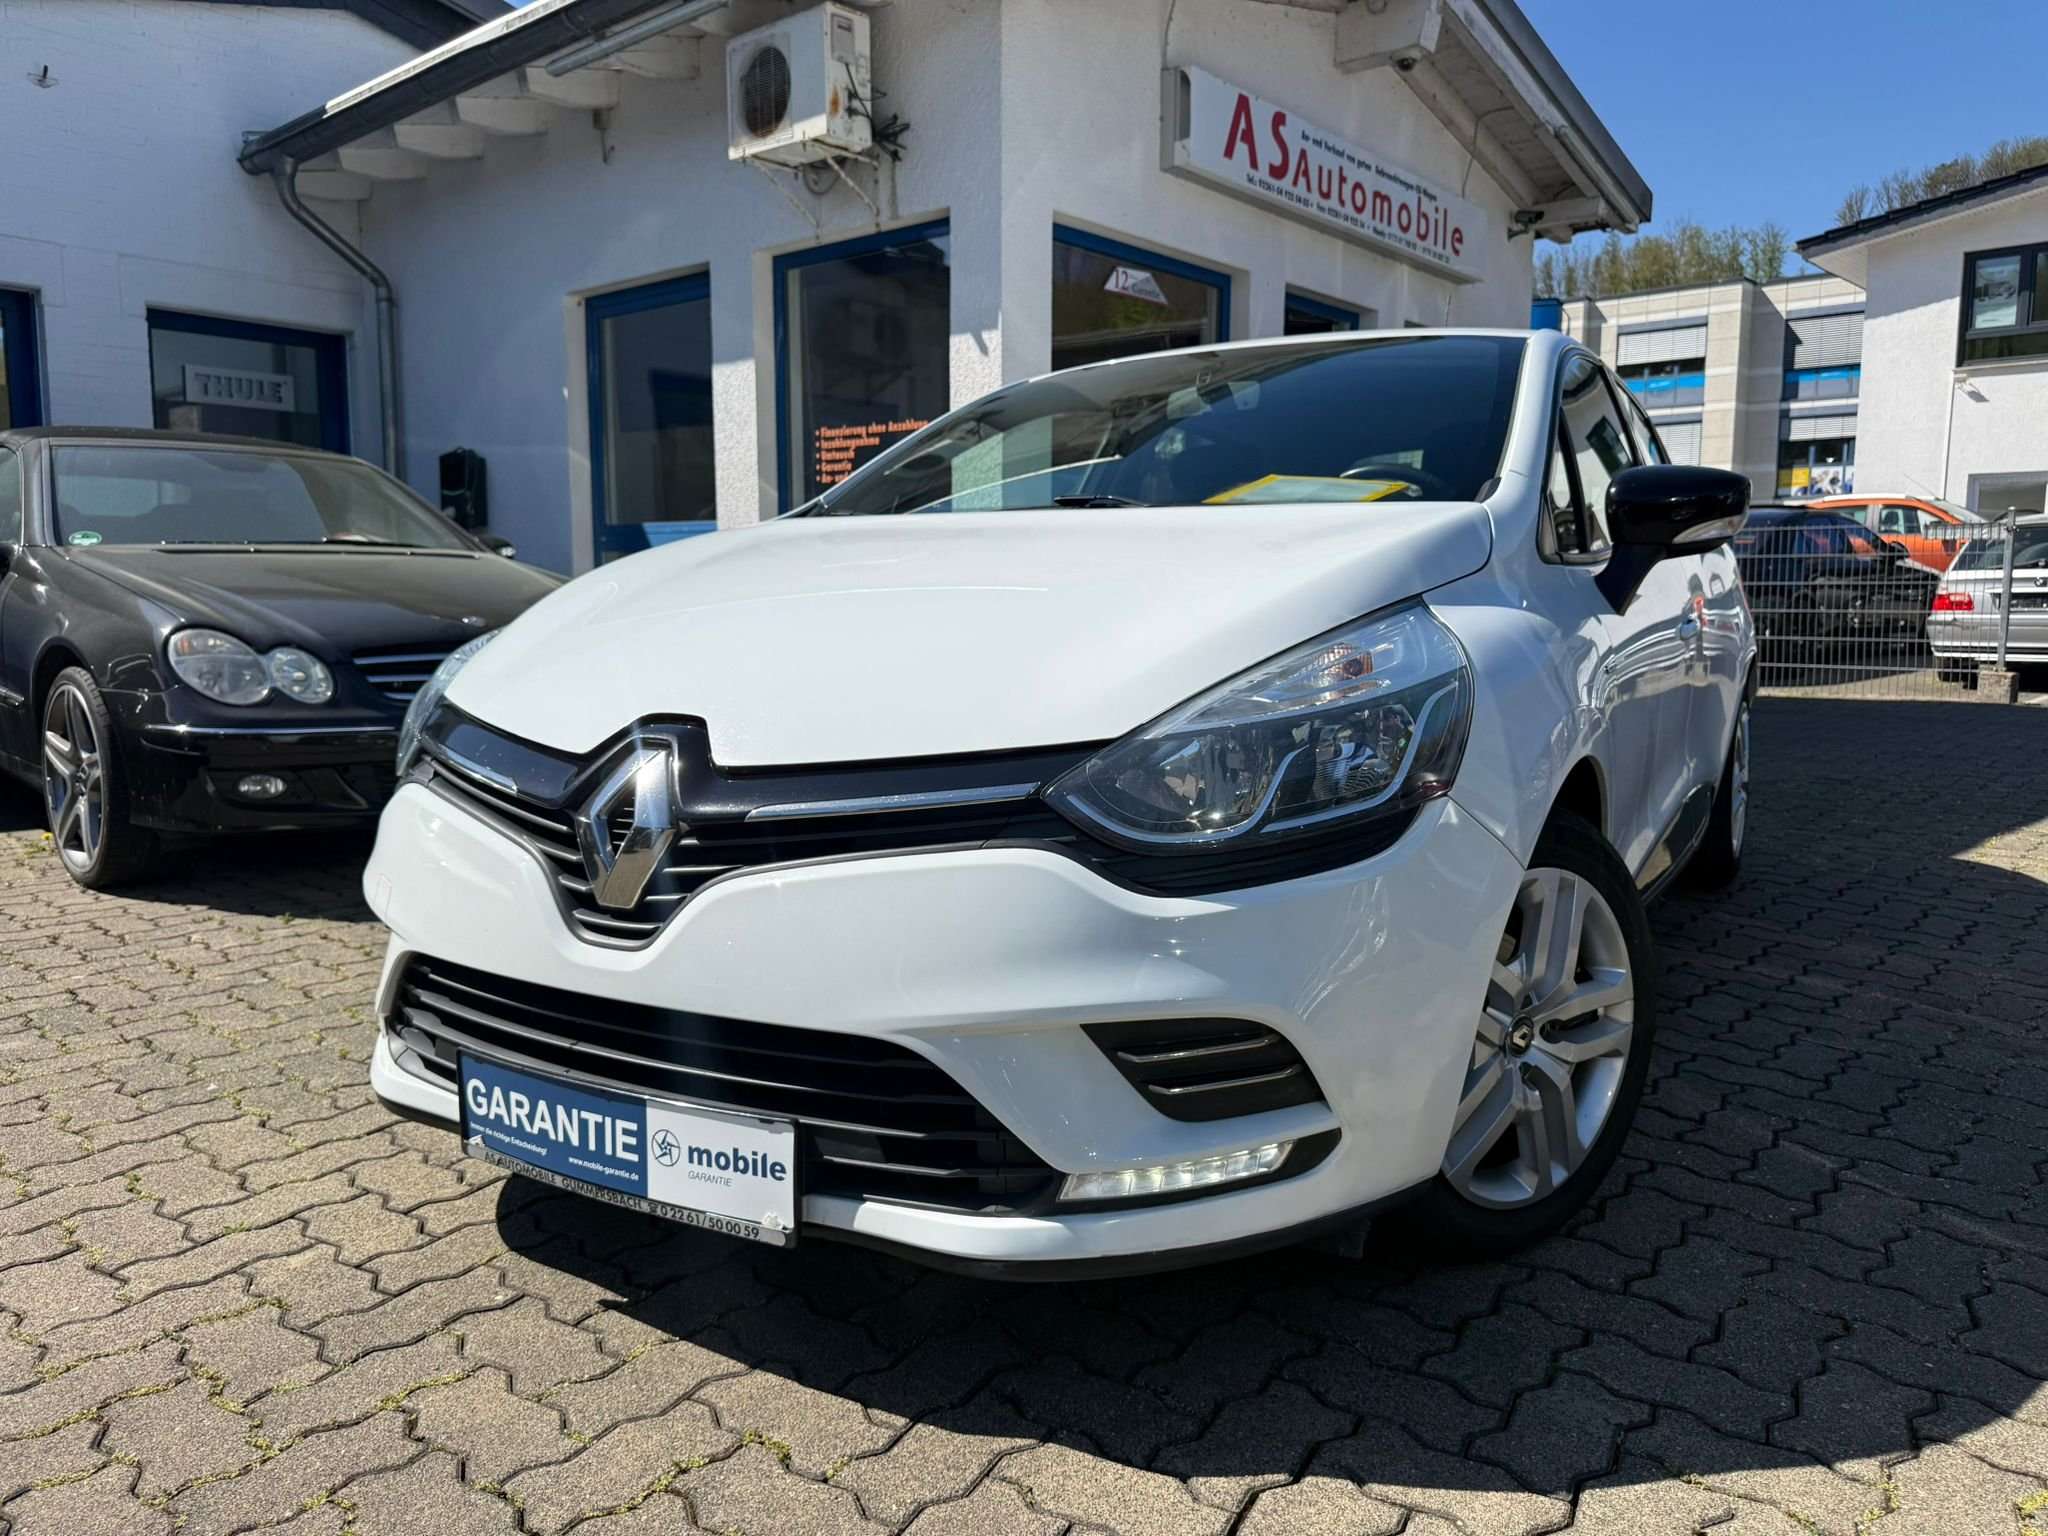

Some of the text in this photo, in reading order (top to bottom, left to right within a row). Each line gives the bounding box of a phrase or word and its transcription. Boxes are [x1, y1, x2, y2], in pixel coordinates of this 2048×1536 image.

[1292, 148, 1464, 257] Automobile
[1113, 268, 1128, 290] 12
[193, 372, 284, 404] THULE
[820, 425, 867, 438] Finanzierung
[868, 421, 887, 435] ohne
[466, 1078, 639, 1163] GARANTIE
[568, 1157, 640, 1181] www.mobile-garantie.de
[688, 1144, 788, 1182] mobile
[688, 1170, 734, 1187] GARANTIE
[496, 1157, 556, 1185] AUTOMOBILE
[562, 1178, 643, 1210] GUMMERSBACH
